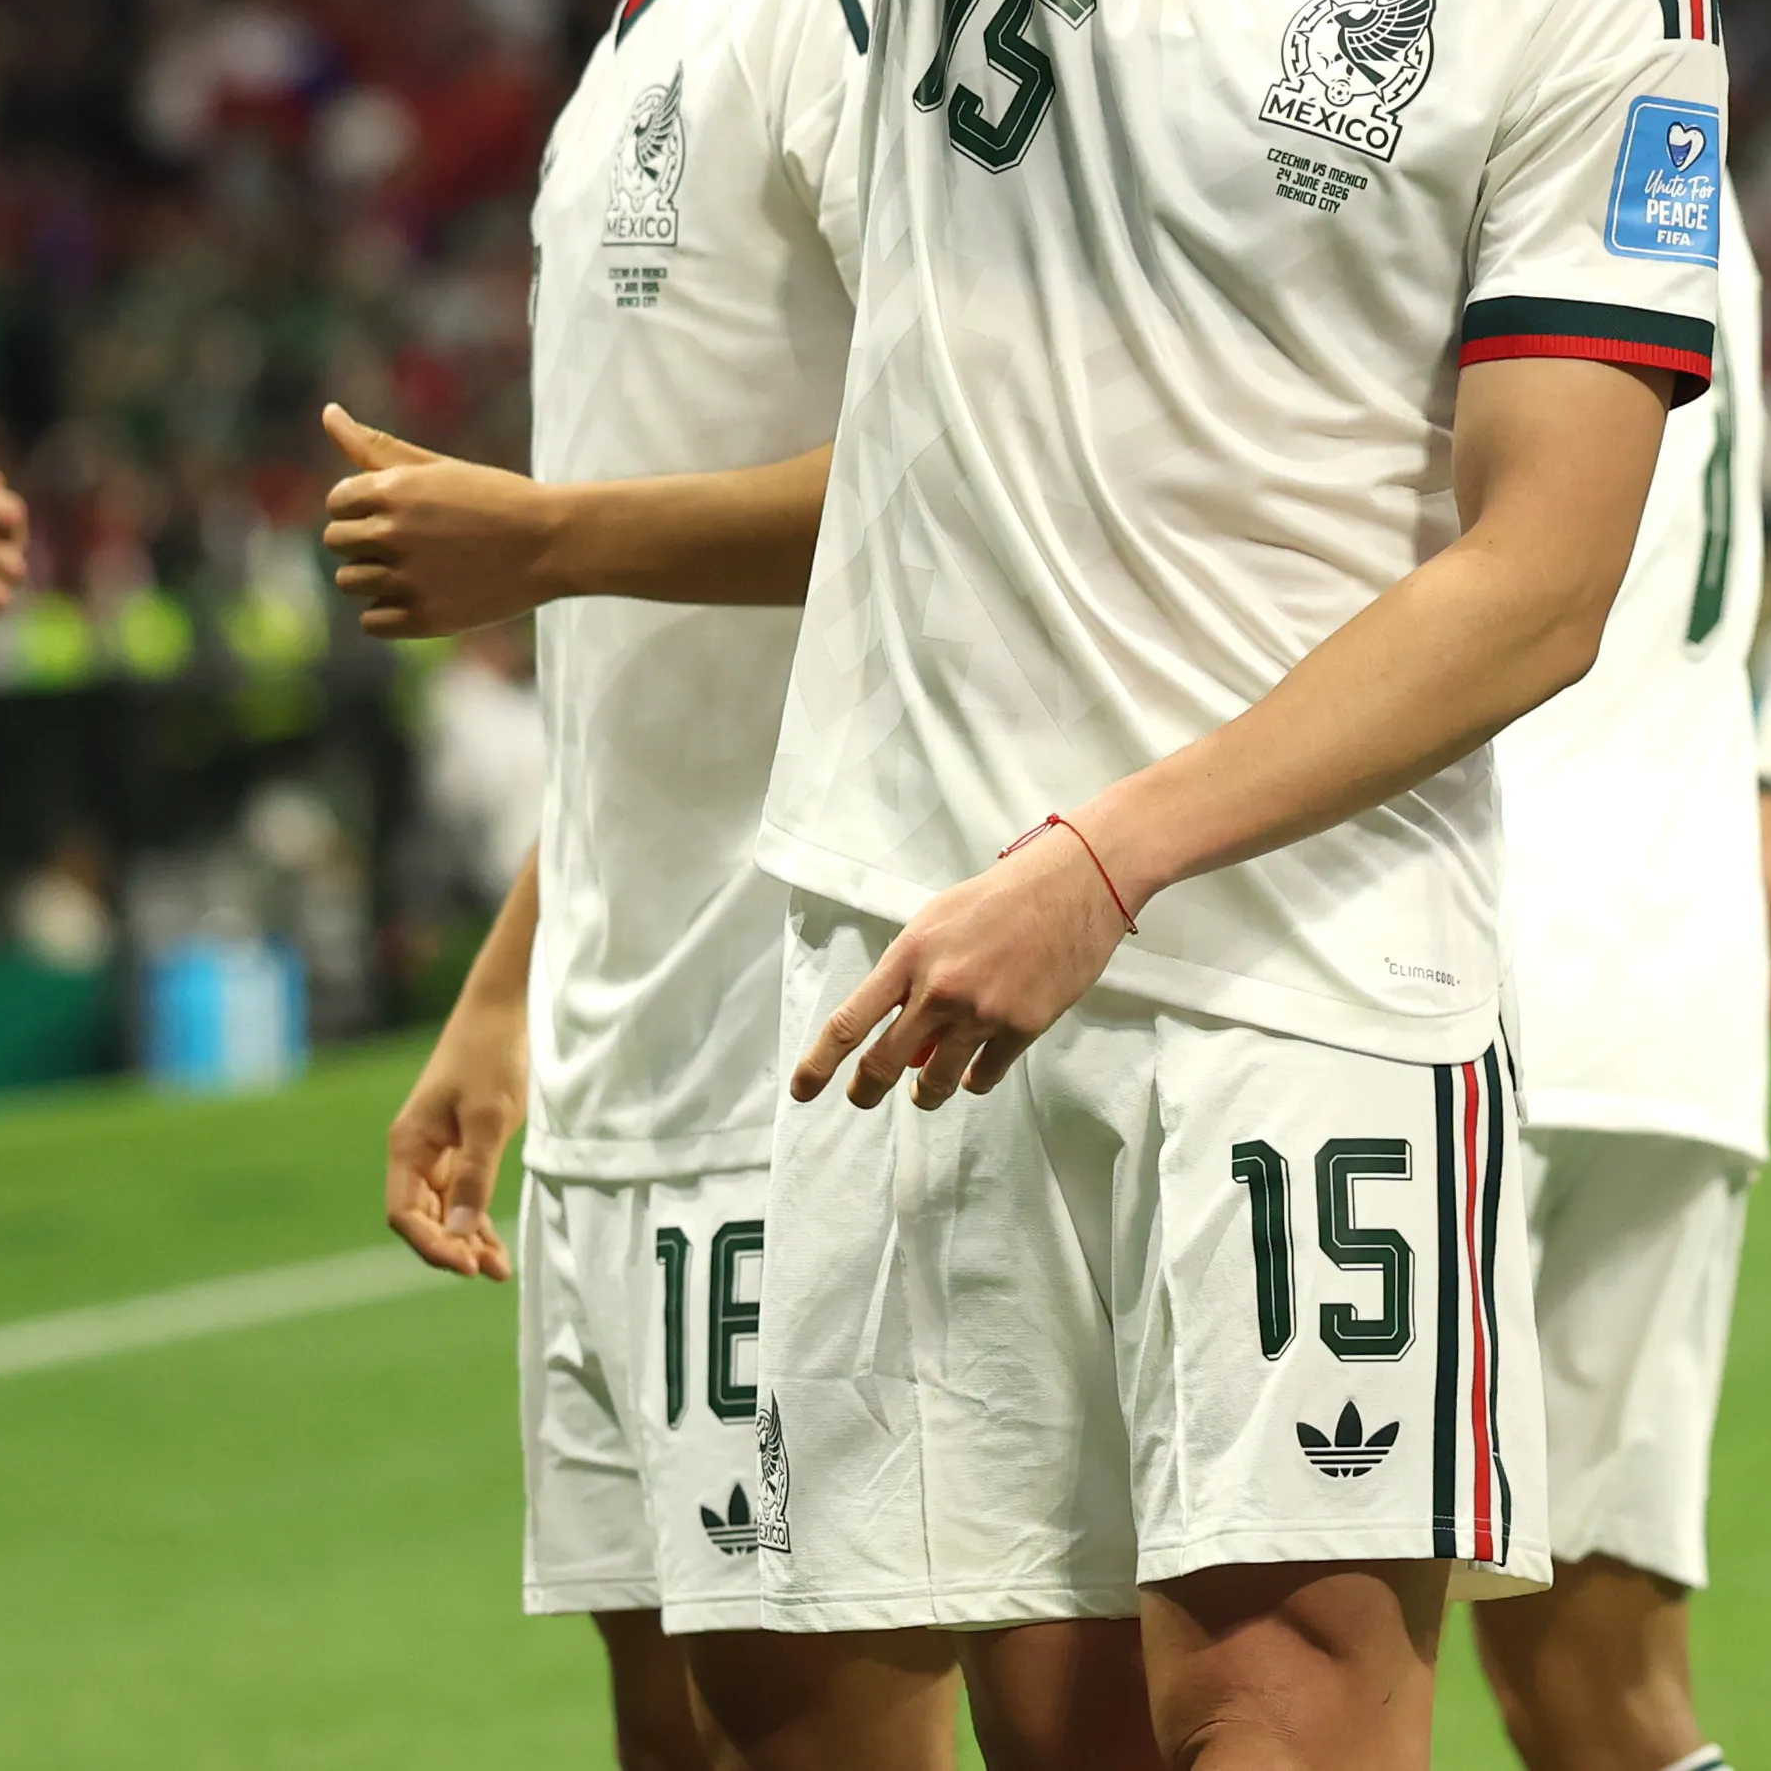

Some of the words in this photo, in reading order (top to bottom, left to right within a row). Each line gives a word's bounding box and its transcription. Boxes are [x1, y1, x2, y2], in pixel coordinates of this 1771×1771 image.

[1267, 93, 1390, 150] MÉXICO
[1267, 148, 1311, 172] CZECHIA
[1312, 161, 1328, 177] VS
[1328, 167, 1368, 191] MEXICO
[1276, 167, 1292, 182] 24
[1292, 172, 1321, 192] JUNE
[1321, 181, 1350, 201] 2026
[1644, 169, 1687, 199] Unite
[1688, 175, 1716, 201] For
[1276, 183, 1317, 207] MEXICO
[1318, 197, 1341, 214] CITY
[1646, 198, 1710, 231] PEACE
[1656, 230, 1692, 246] FIFA
[1232, 1138, 1416, 1362] 15
